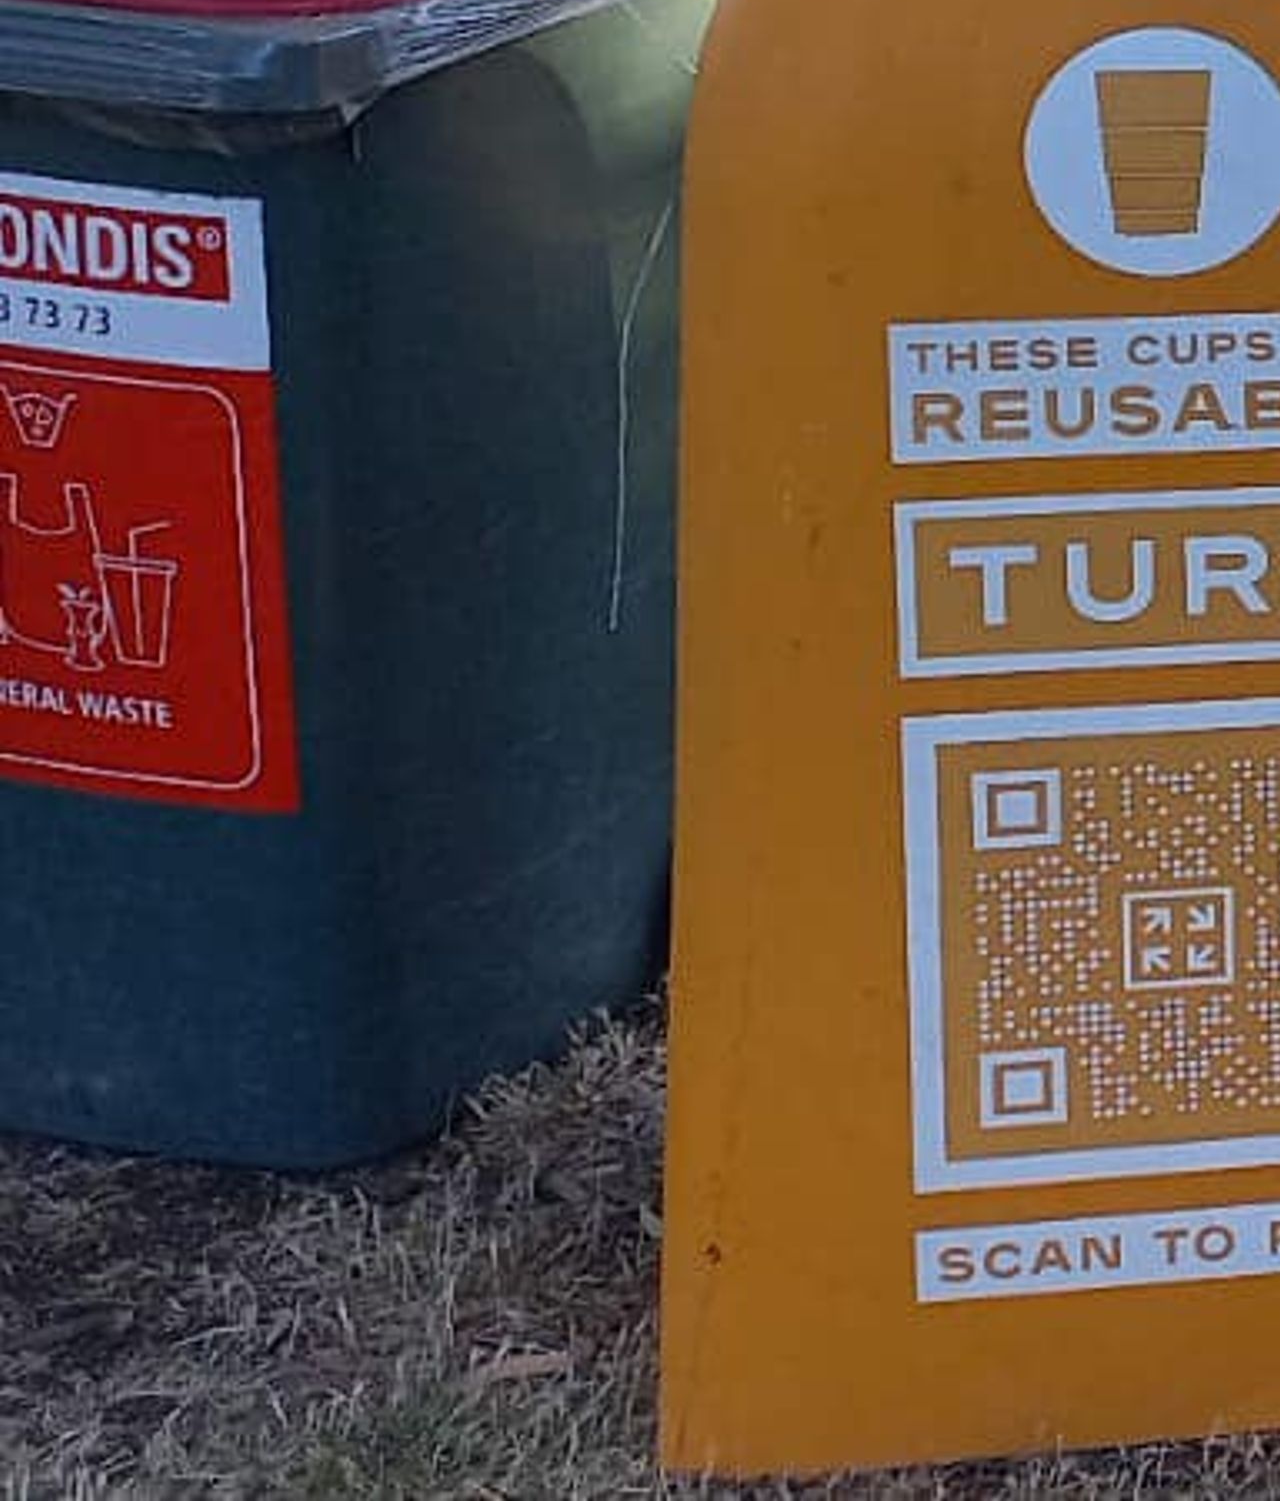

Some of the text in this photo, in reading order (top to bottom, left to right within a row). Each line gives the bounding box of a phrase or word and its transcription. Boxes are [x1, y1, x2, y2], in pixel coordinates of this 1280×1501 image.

[25, 297, 60, 329] 73
[72, 303, 111, 335] 73
[907, 337, 1098, 374] THESE
[1127, 331, 1276, 365] CUPS
[77, 691, 173, 728] WASTE
[937, 1233, 1124, 1283] SCAN
[1154, 1225, 1237, 1265] TO
